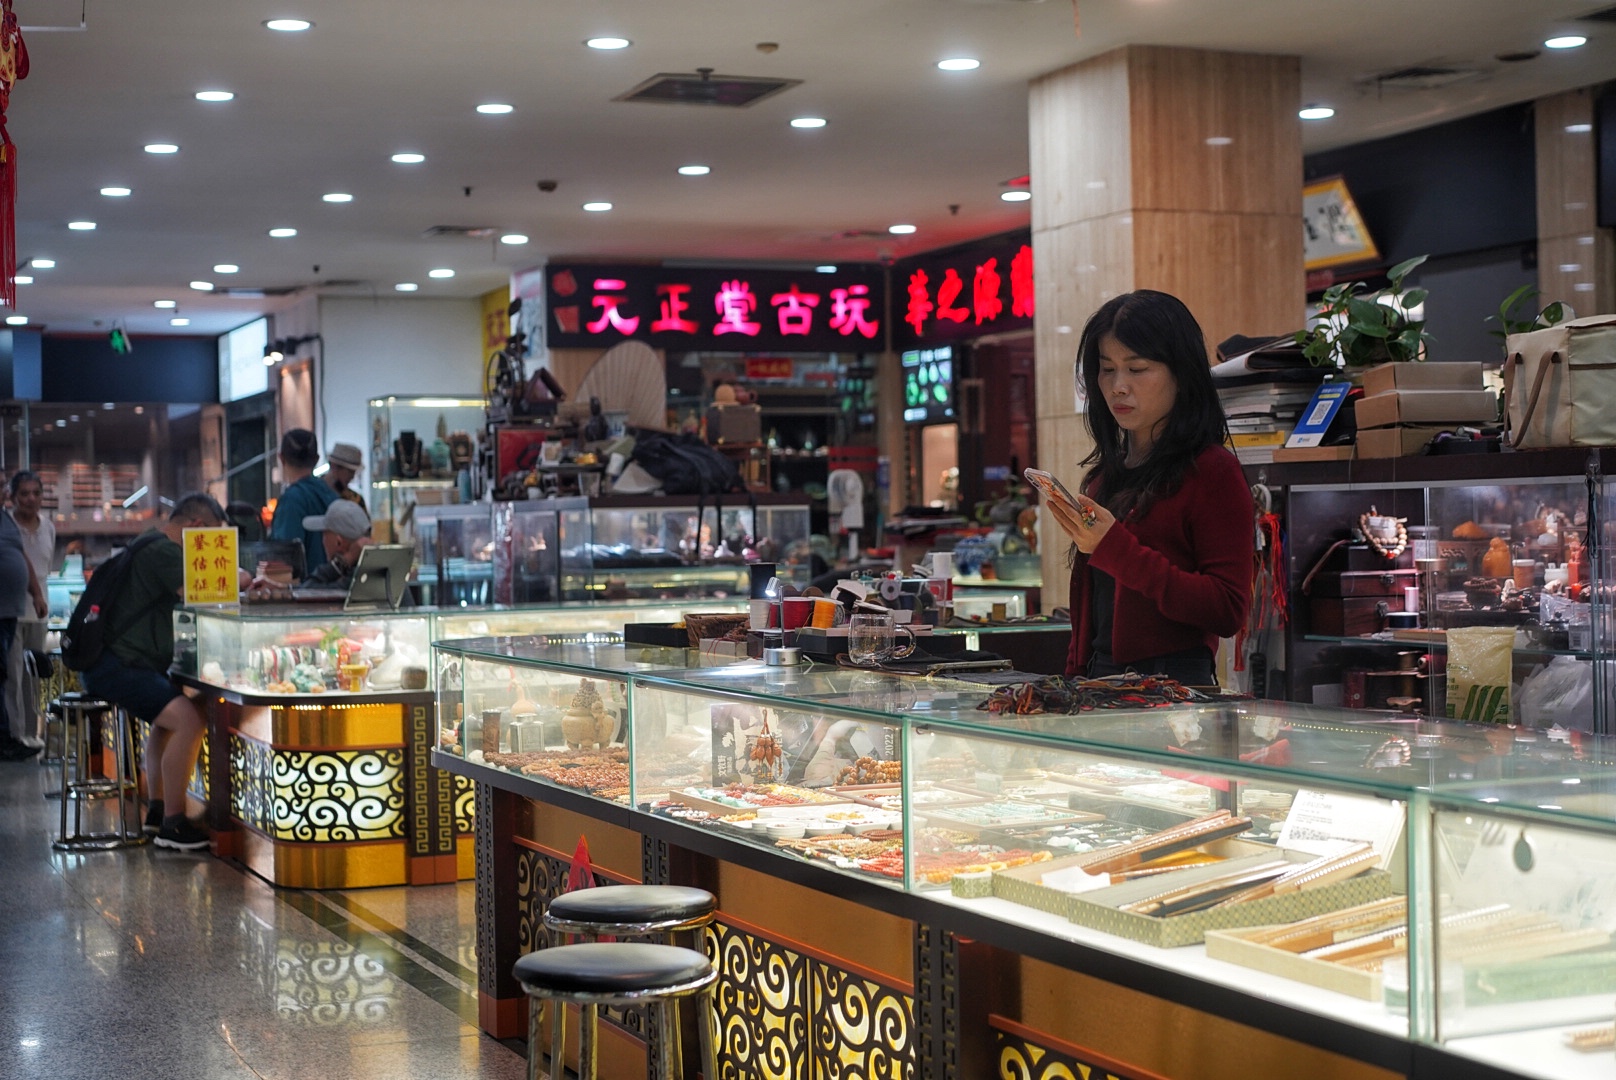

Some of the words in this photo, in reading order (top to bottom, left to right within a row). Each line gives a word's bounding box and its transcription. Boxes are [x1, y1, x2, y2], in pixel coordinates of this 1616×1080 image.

[586, 278, 879, 339] 元正堂古玩
[192, 555, 231, 571] 估价
[884, 734, 894, 756] 2022
